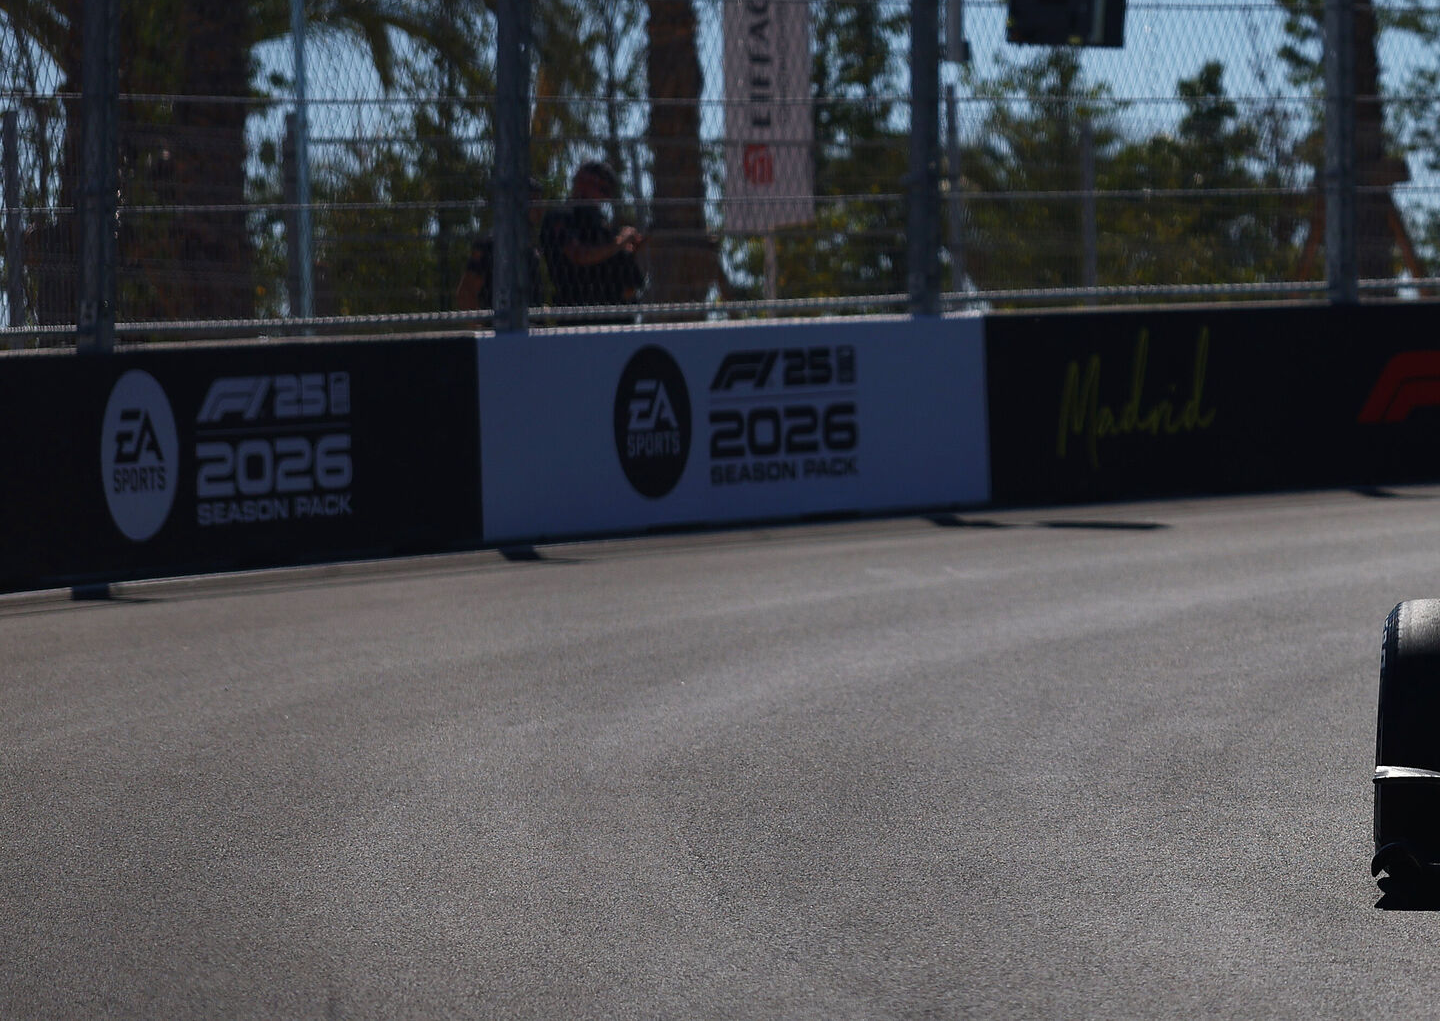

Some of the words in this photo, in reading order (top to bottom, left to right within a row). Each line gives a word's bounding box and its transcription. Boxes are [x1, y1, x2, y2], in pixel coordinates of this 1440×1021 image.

[628, 381, 678, 429] EA
[1056, 325, 1217, 471] Madrid
[113, 409, 164, 463] EA
[627, 431, 680, 457] SPORTS
[710, 403, 857, 458] 2026
[113, 465, 165, 493] SPORTS
[196, 435, 352, 496] 2026
[711, 461, 796, 485] SEASON
[804, 457, 858, 477] PACK
[198, 499, 288, 525] SEASON
[295, 494, 352, 518] PACK
